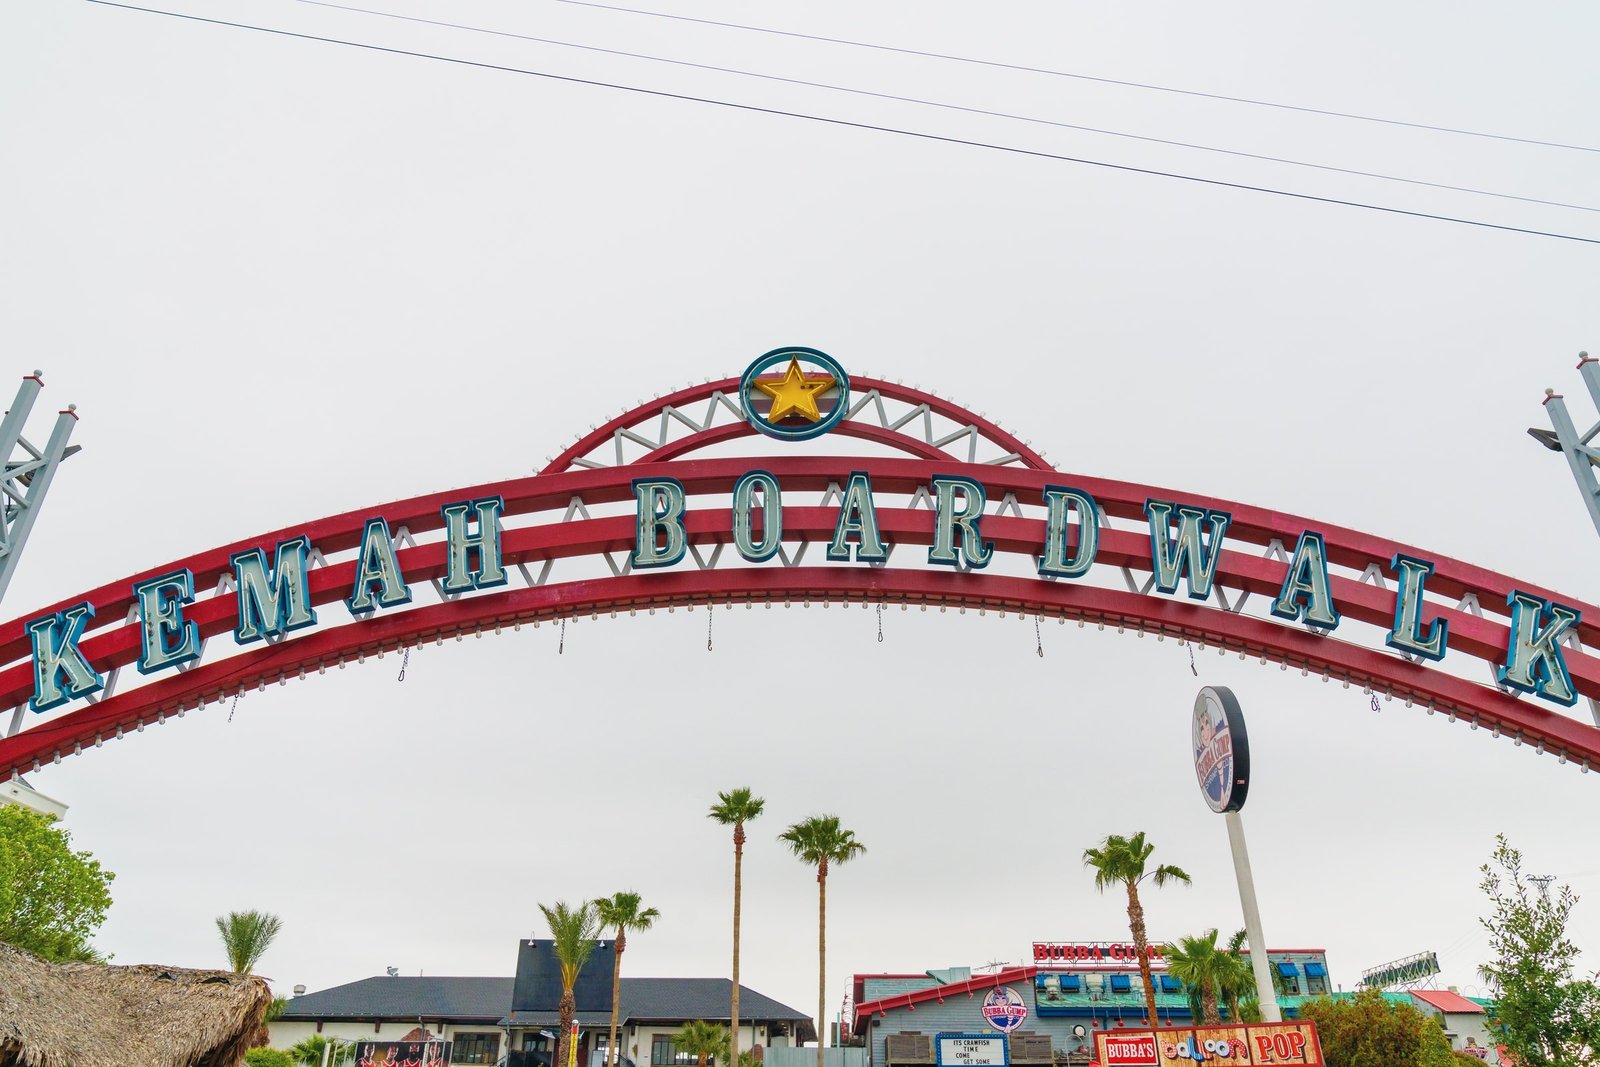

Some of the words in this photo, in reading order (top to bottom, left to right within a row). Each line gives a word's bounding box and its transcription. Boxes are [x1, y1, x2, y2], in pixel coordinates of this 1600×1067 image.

[24, 495, 509, 714] KEMAH
[631, 469, 1581, 708] BOARDWALK
[1033, 944, 1104, 961] BUBBA
[1109, 943, 1167, 961] GU
[984, 1007, 1006, 1016] BUBBA
[1007, 1005, 1026, 1016] GUMP
[1107, 1043, 1154, 1058] BUBBA'S
[1255, 1031, 1306, 1061] POP
